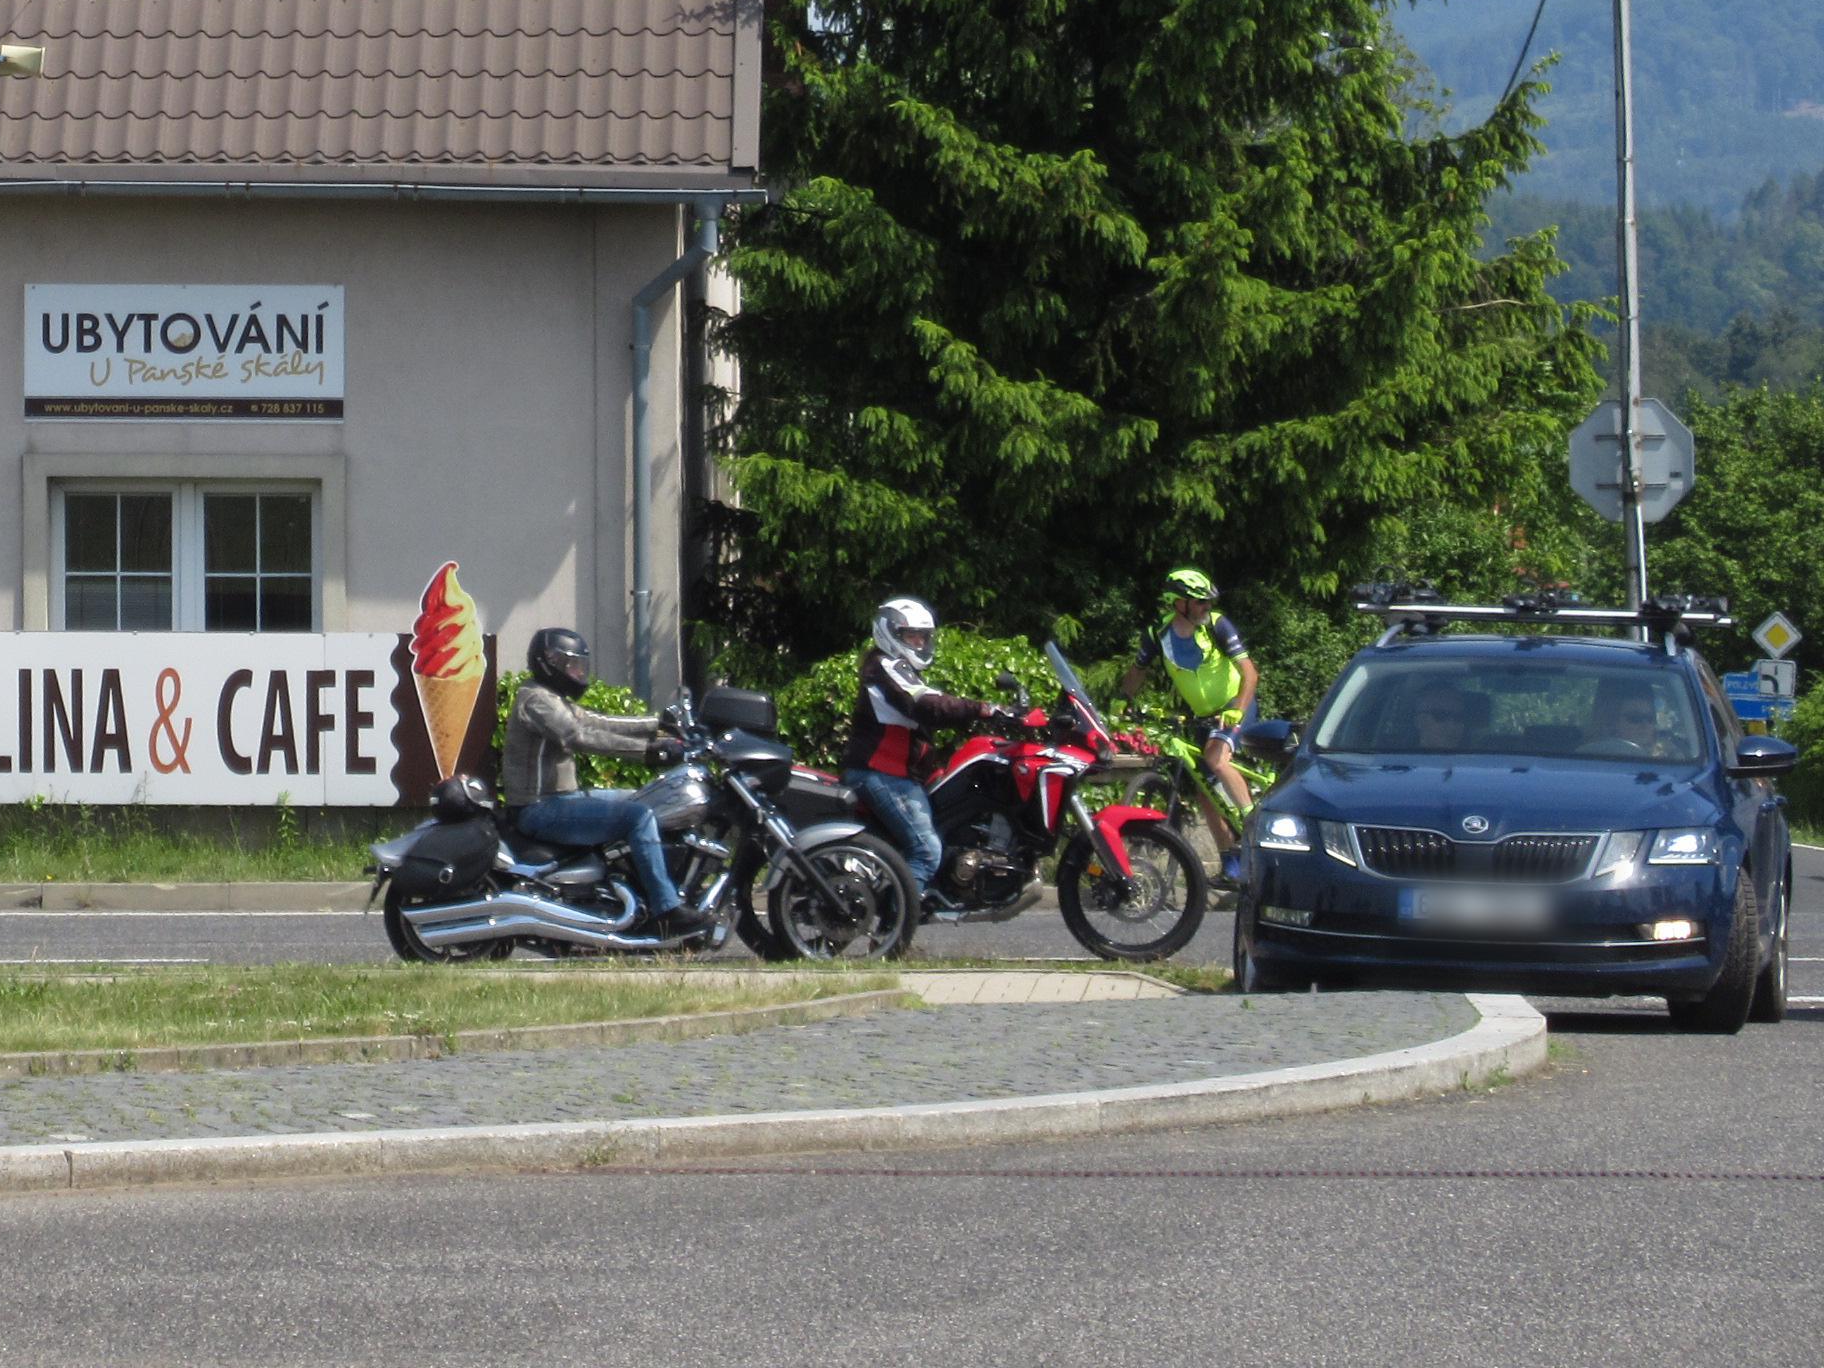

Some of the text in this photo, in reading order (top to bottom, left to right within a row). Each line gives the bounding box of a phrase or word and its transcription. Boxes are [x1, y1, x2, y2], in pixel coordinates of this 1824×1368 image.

[42, 301, 329, 354] UBYTOVÁNÍ
[90, 350, 324, 386] U Panské skály
[149, 667, 192, 774] &
[216, 668, 376, 775] CAFE
